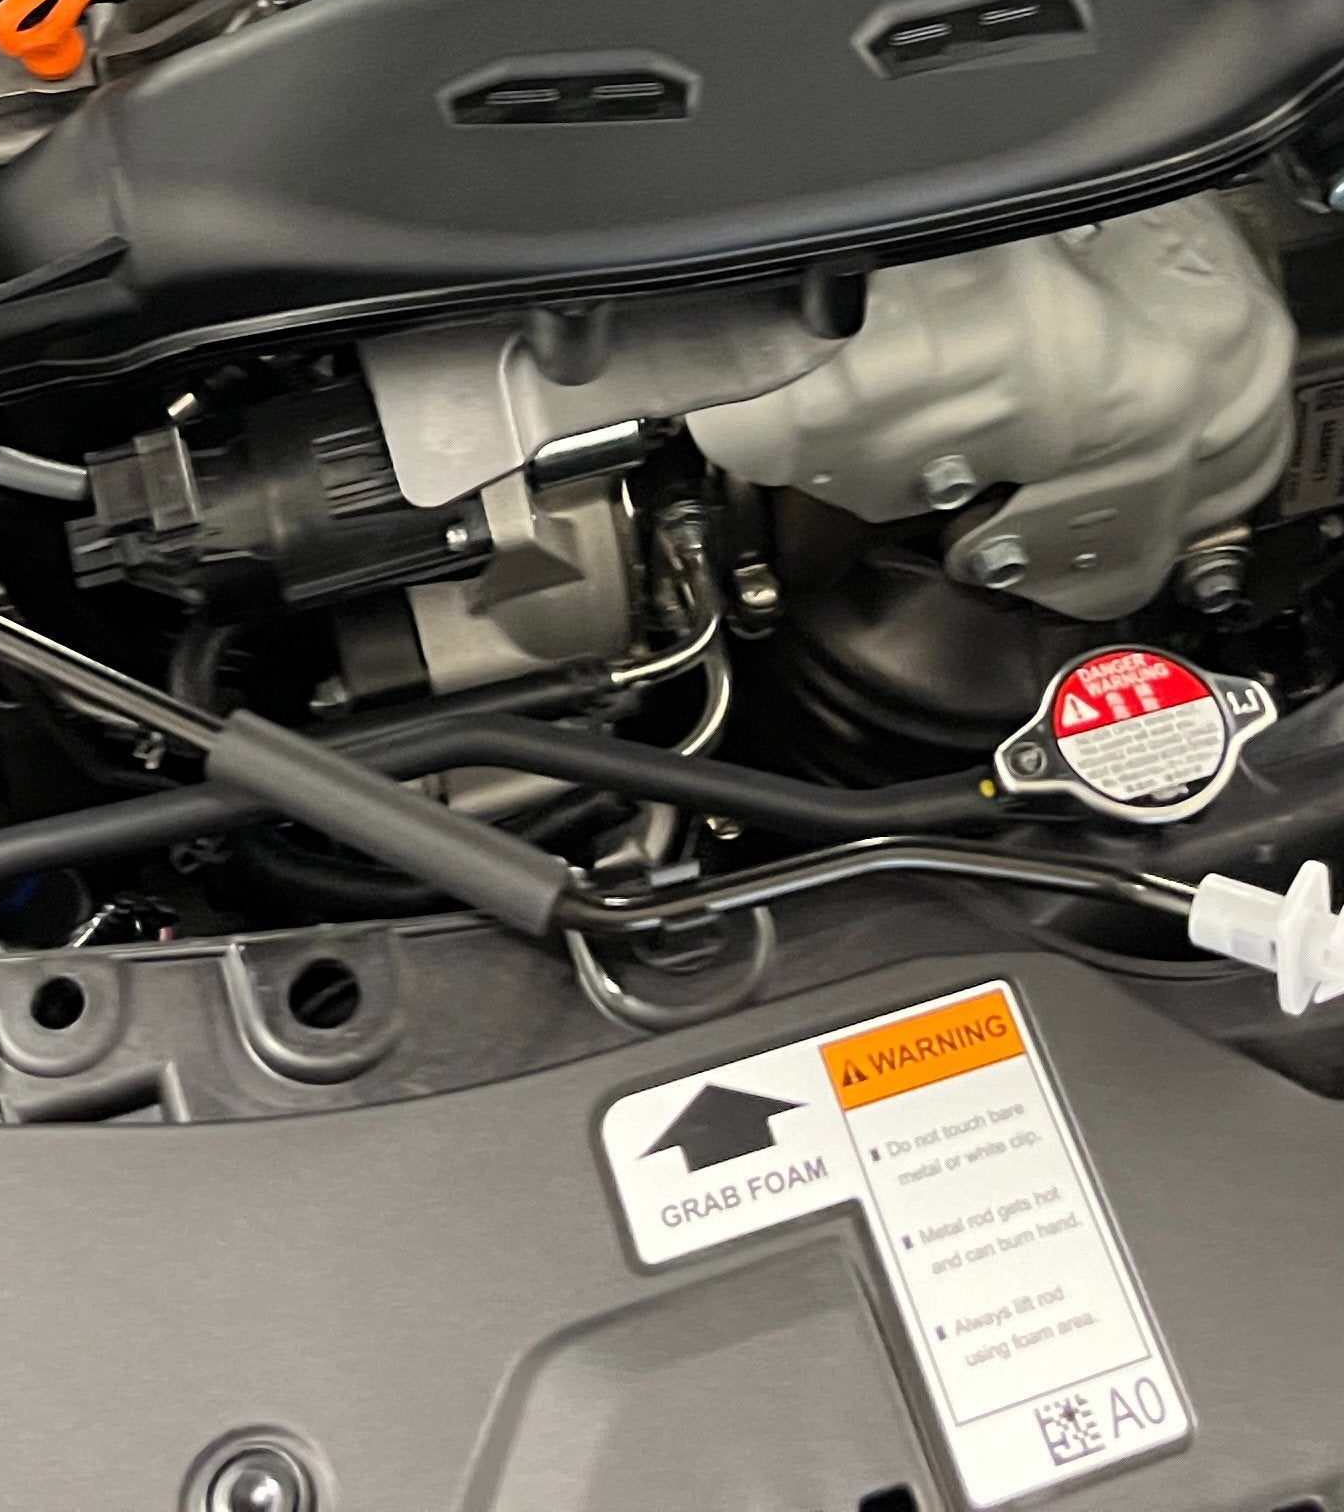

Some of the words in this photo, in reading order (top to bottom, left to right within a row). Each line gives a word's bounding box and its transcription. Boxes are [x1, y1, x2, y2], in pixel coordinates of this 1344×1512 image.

[1075, 652, 1148, 683] DANGER
[1085, 662, 1170, 699] WARNING
[868, 1014, 1008, 1076] WARNING
[886, 1140, 912, 1157] Do
[914, 1129, 941, 1149] not
[942, 1114, 987, 1139] touch
[987, 1103, 1026, 1124] bare
[898, 1158, 943, 1186] metal
[945, 1155, 962, 1171] or
[965, 1141, 1008, 1164] white
[661, 1186, 742, 1229] GRAB
[747, 1155, 828, 1201] FOAM
[918, 1217, 965, 1246] Metal
[967, 1207, 995, 1228] rod
[997, 1197, 1033, 1223] gets
[1032, 1185, 1061, 1206] hot
[932, 1252, 964, 1275] and
[964, 1244, 996, 1263] can
[996, 1230, 1035, 1252] burn
[1035, 1211, 1083, 1238] hand.
[955, 1306, 1013, 1335] Always
[1012, 1295, 1036, 1315] lift
[1036, 1284, 1066, 1308] rod
[965, 1342, 1012, 1367] using
[1011, 1325, 1056, 1350] foam
[1110, 1376, 1167, 1439] A0
